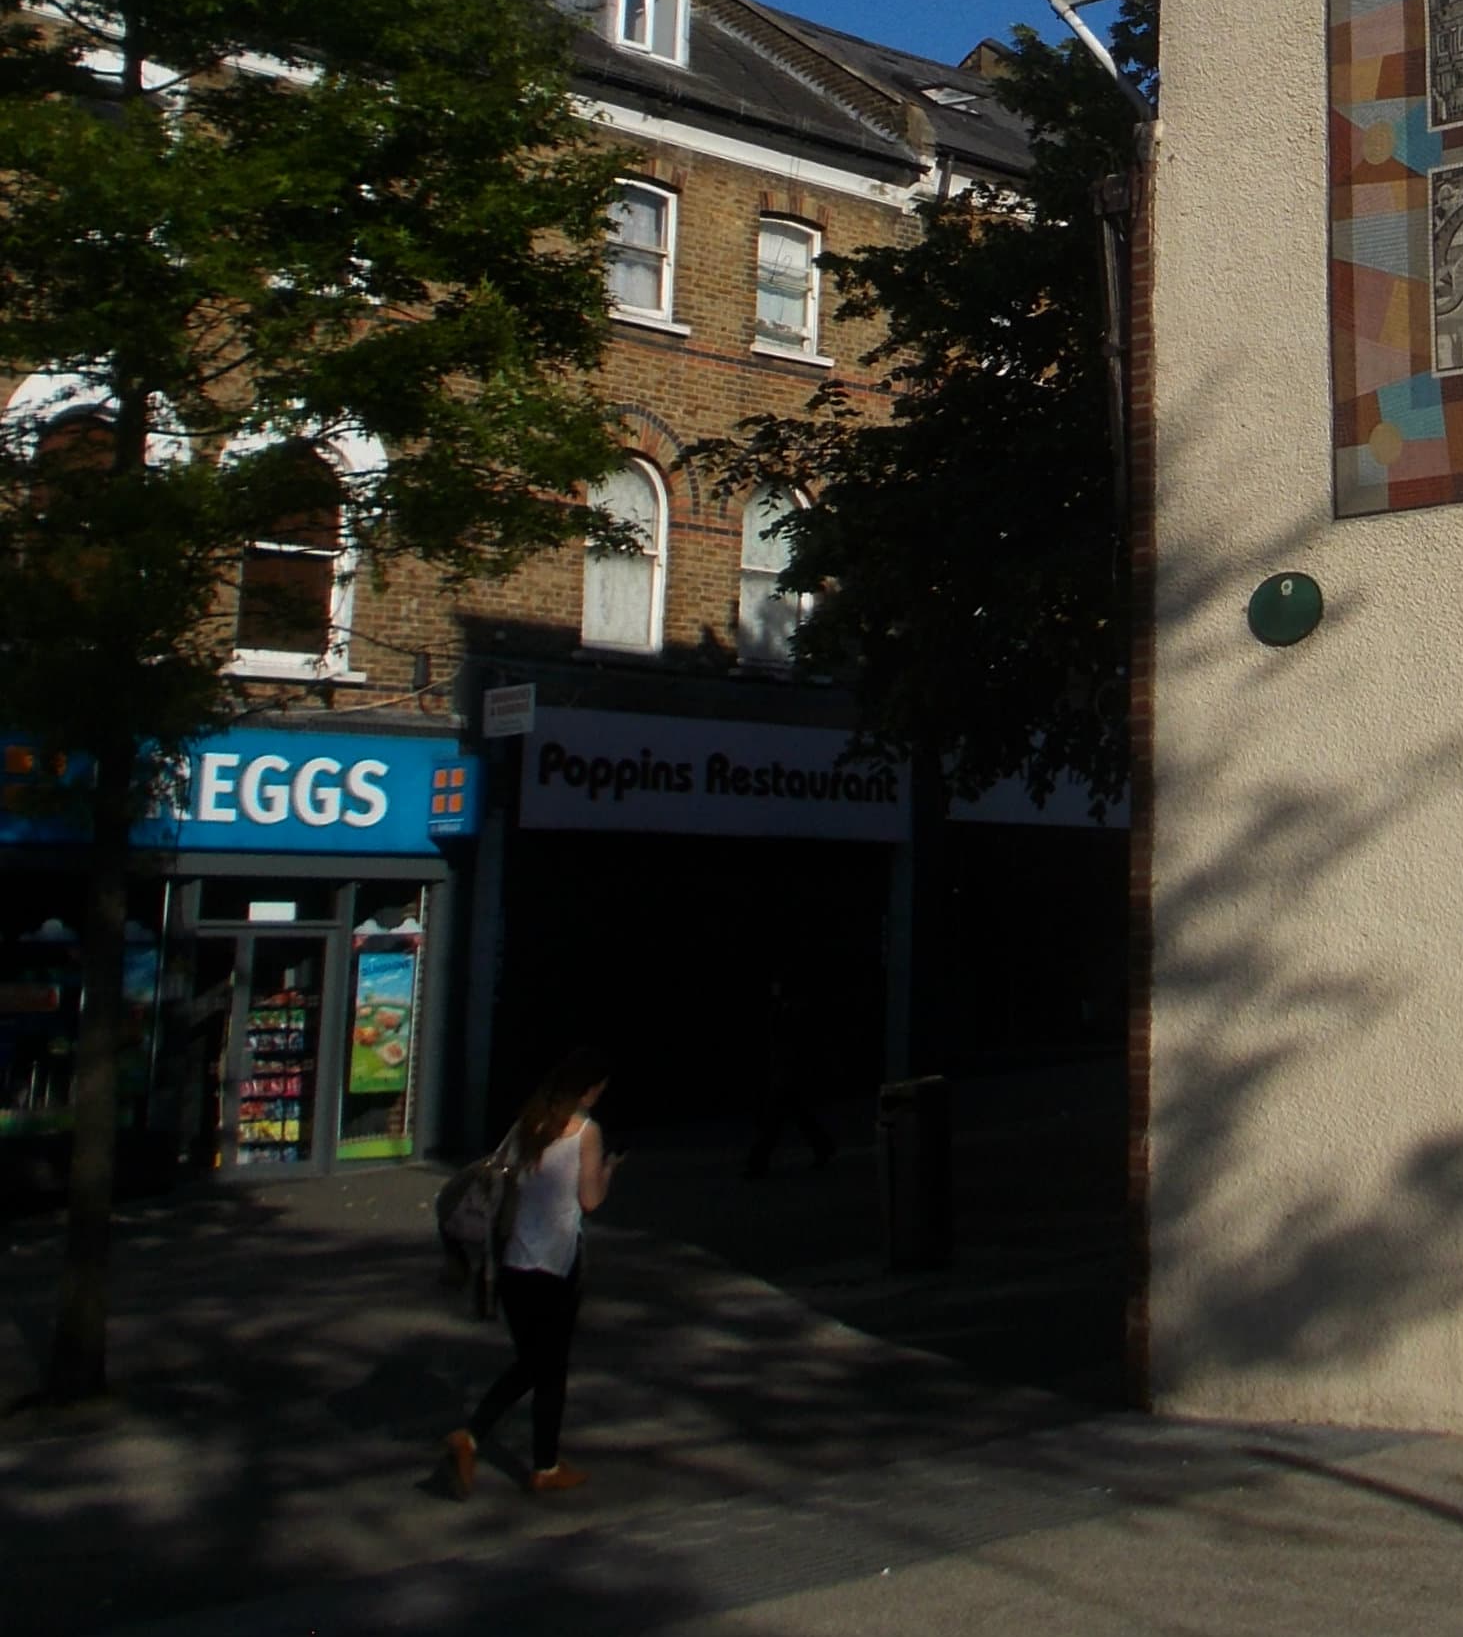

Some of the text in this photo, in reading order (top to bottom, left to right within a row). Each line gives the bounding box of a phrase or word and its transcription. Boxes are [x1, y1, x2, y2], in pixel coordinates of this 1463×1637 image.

[93, 752, 391, 828] REGGS
[539, 742, 898, 803] Poppins Restaurant
